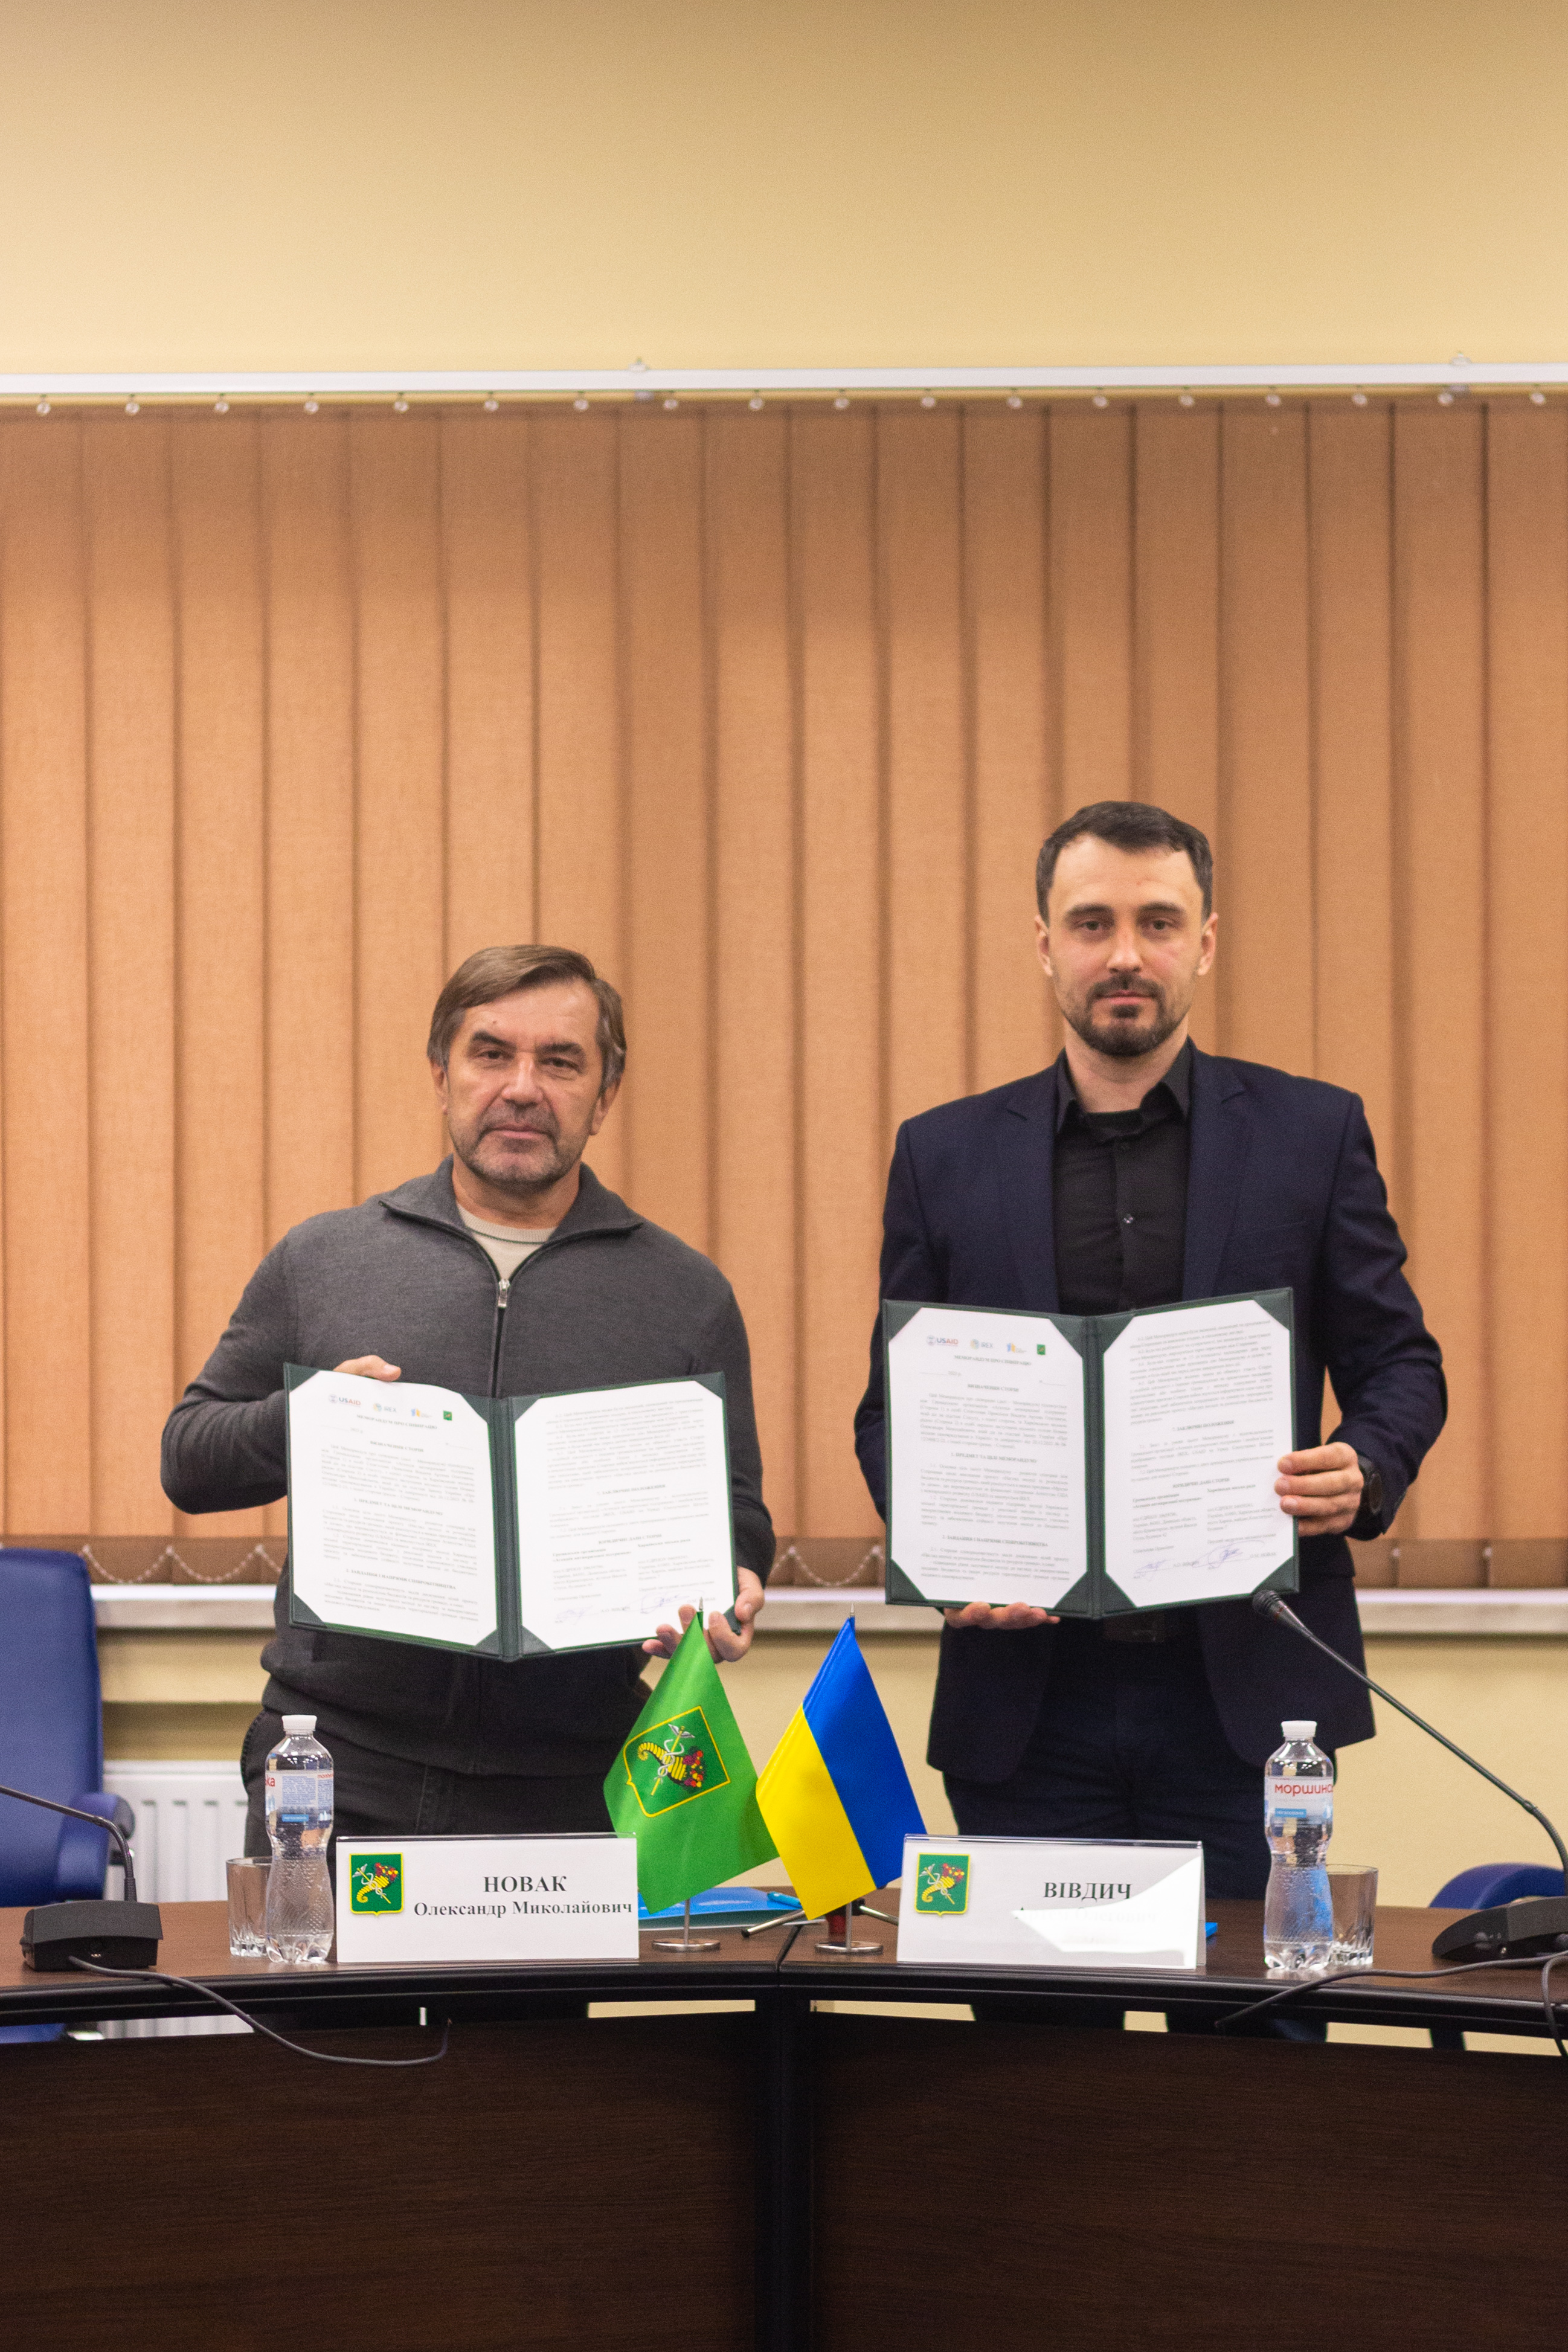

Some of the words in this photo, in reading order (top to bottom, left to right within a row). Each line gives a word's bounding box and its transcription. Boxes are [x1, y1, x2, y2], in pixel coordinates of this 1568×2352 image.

[936, 1337, 959, 1345] USAID
[338, 1396, 361, 1406] USAID
[483, 1875, 567, 1893] НОВАК
[1043, 1881, 1133, 1902] ВІВДИЧ
[414, 1902, 507, 1918] Олександр
[512, 1900, 633, 1915] Миколайович
